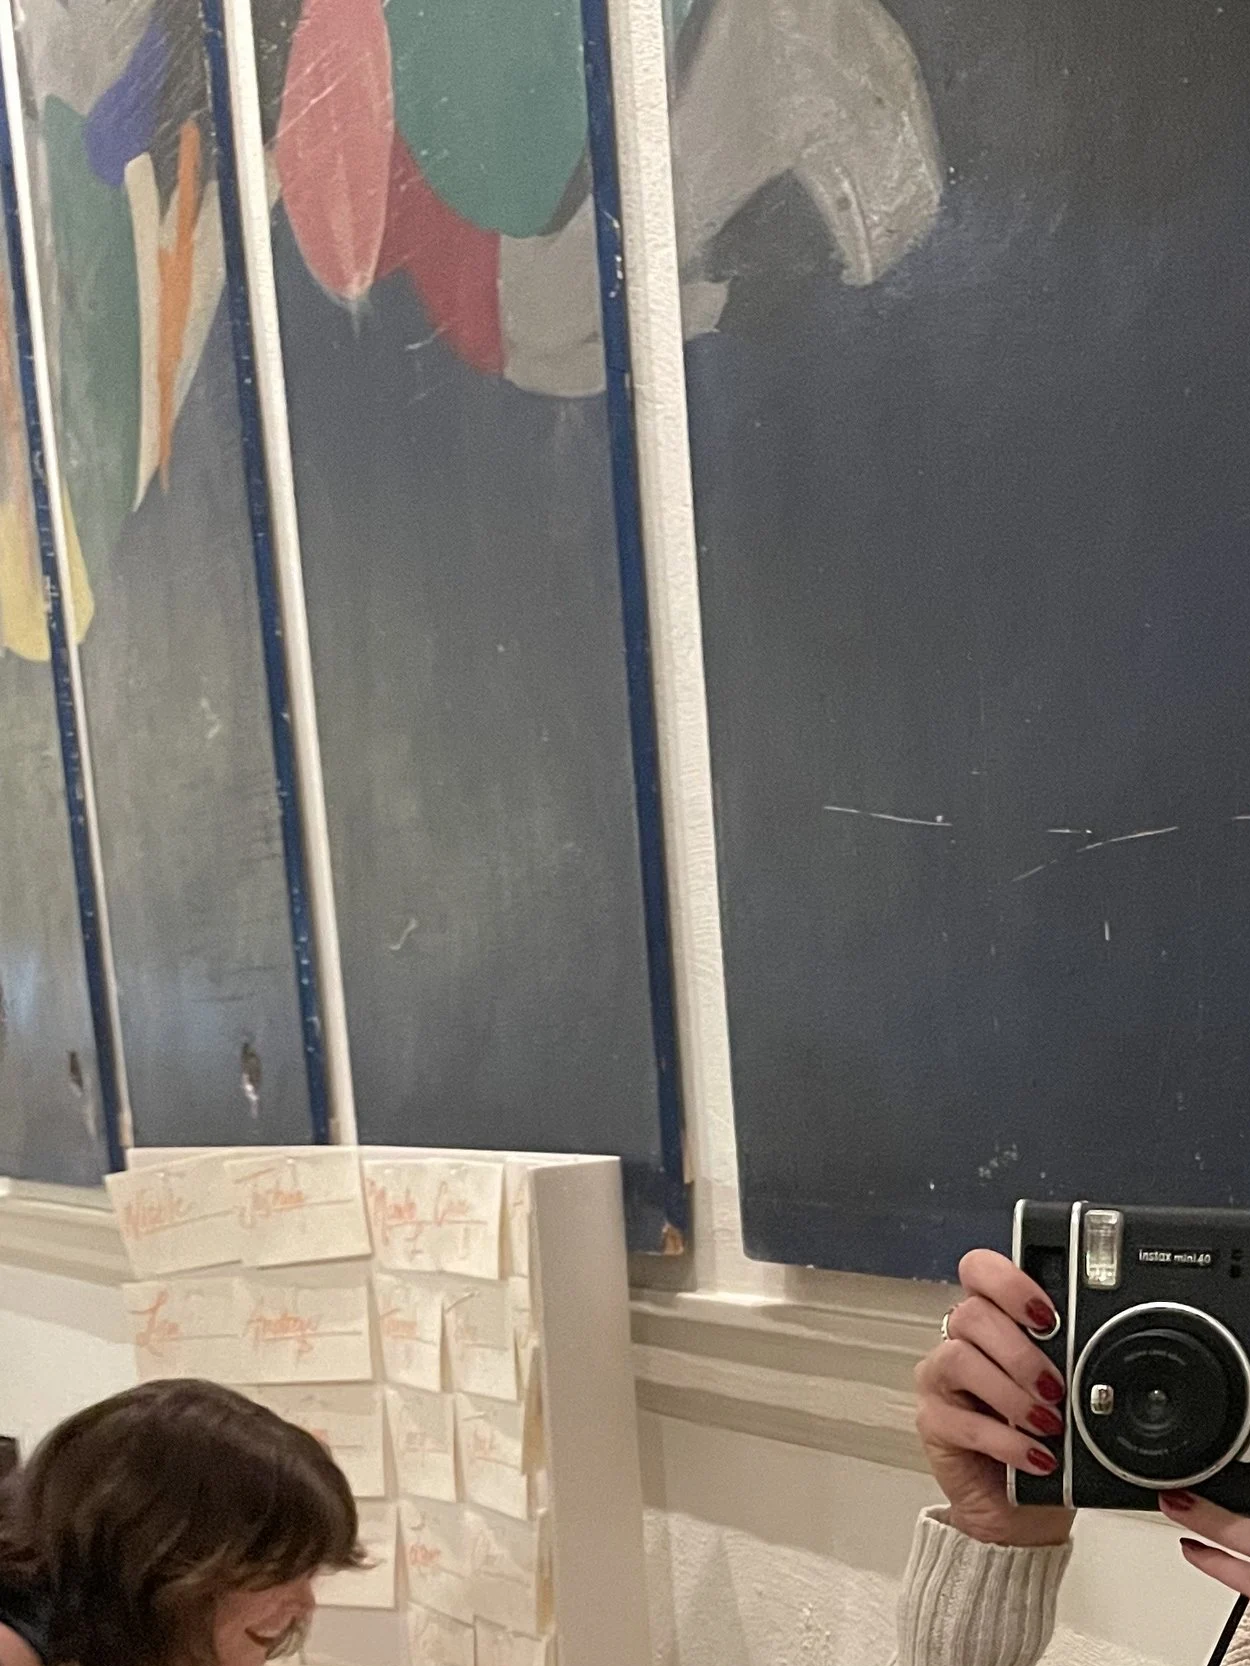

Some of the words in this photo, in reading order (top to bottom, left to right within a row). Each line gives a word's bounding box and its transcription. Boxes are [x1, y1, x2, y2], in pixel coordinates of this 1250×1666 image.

[1139, 1248, 1172, 1262] instax
[1174, 1252, 1196, 1264] mini
[1197, 1253, 1212, 1266] 40
